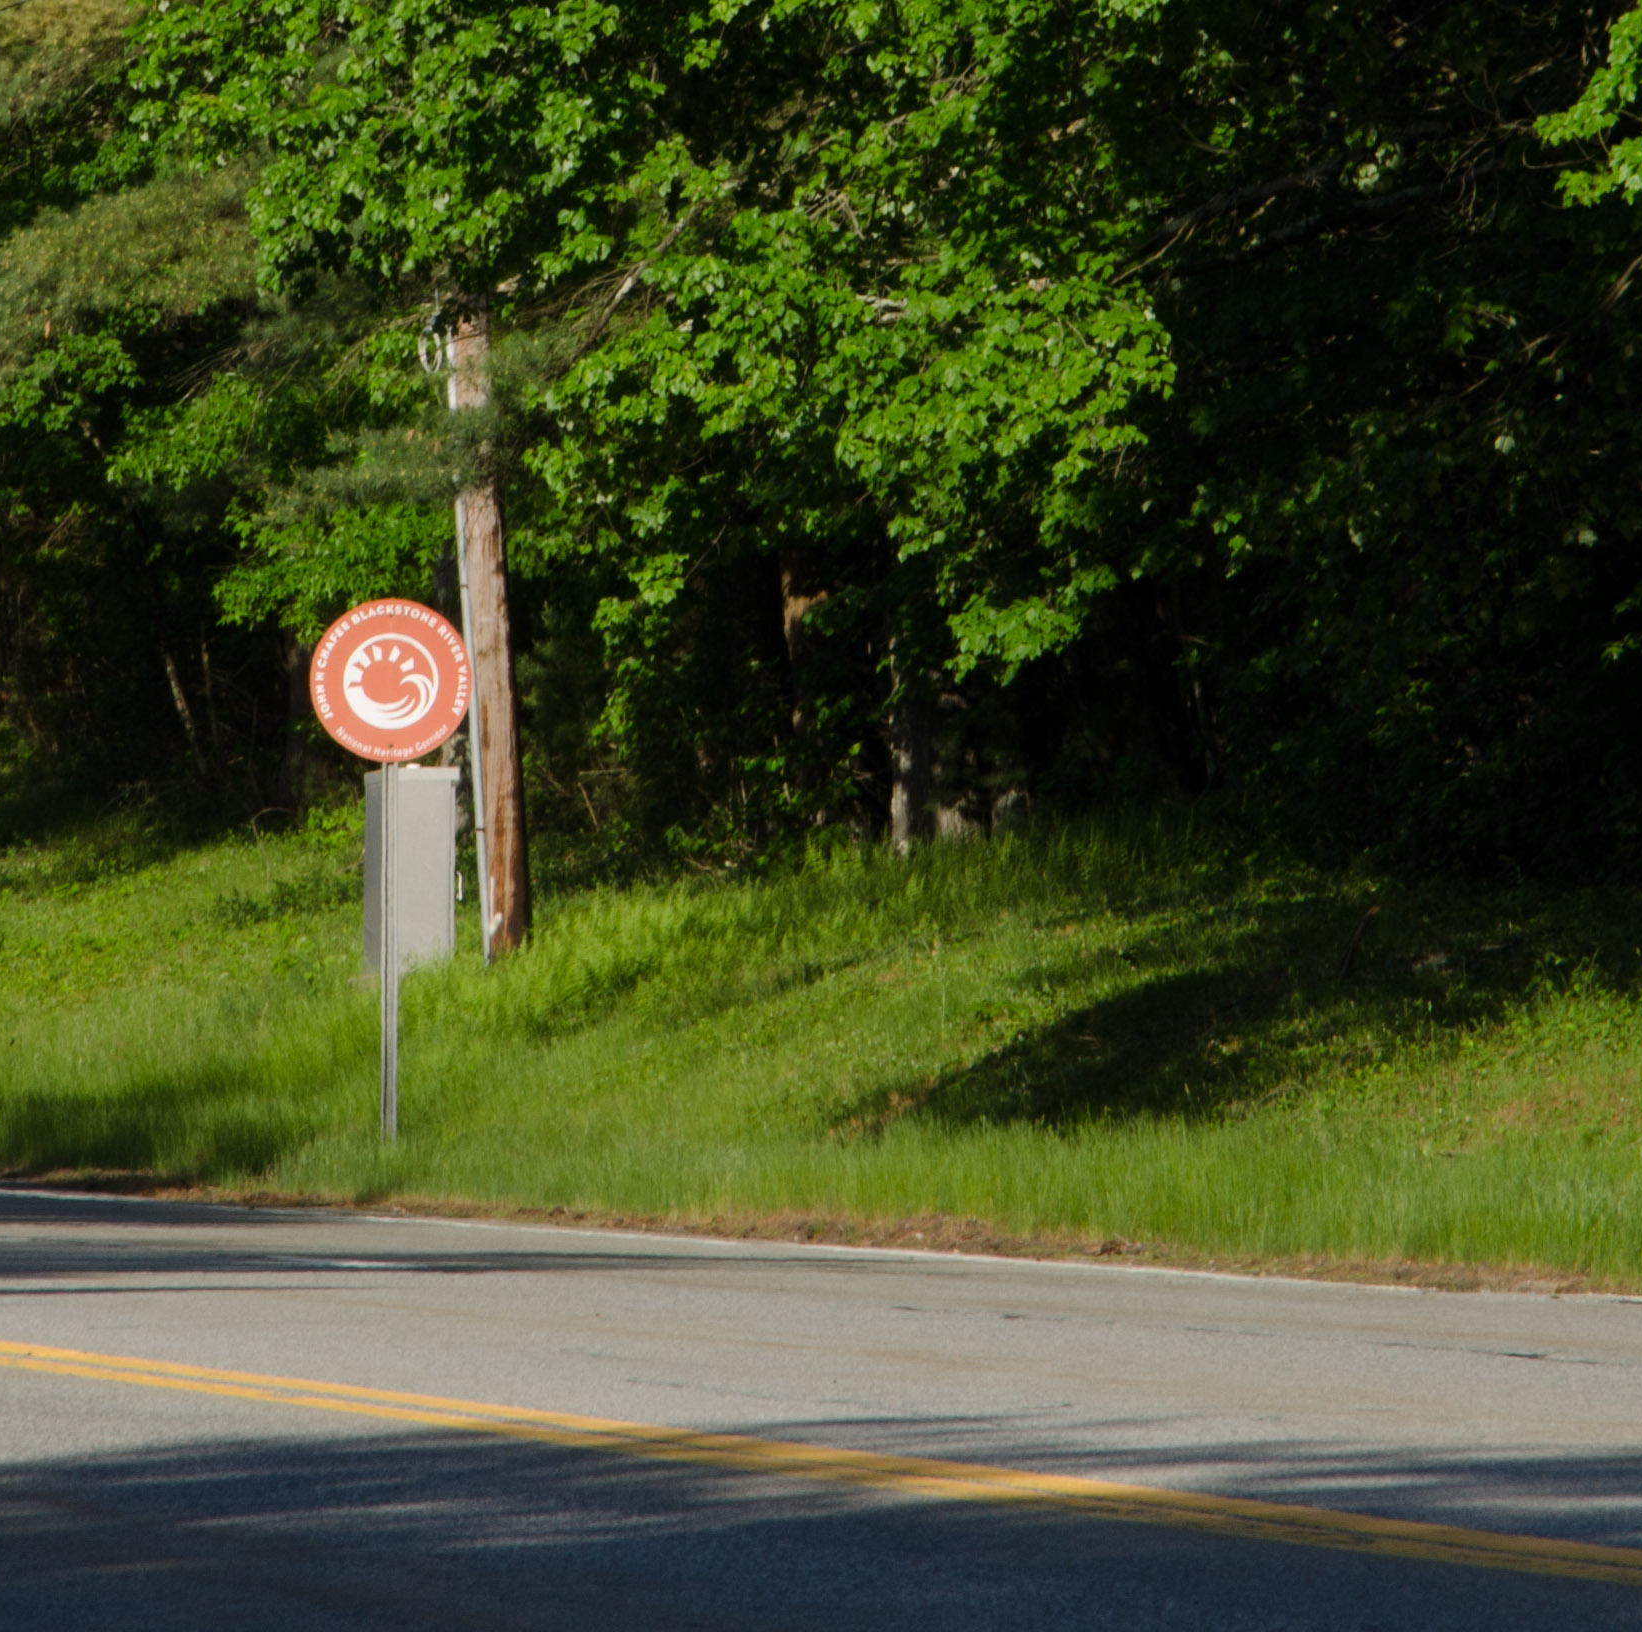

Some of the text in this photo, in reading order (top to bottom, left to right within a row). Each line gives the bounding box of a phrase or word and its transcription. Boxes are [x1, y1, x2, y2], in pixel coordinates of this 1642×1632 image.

[350, 604, 438, 628] BLACKSTONE
[317, 622, 351, 669] CHAFEE
[437, 624, 464, 664] RIVER
[315, 685, 333, 720] JOHN
[451, 666, 469, 717] VALLEY
[335, 724, 449, 758] National Heritage Corridor
